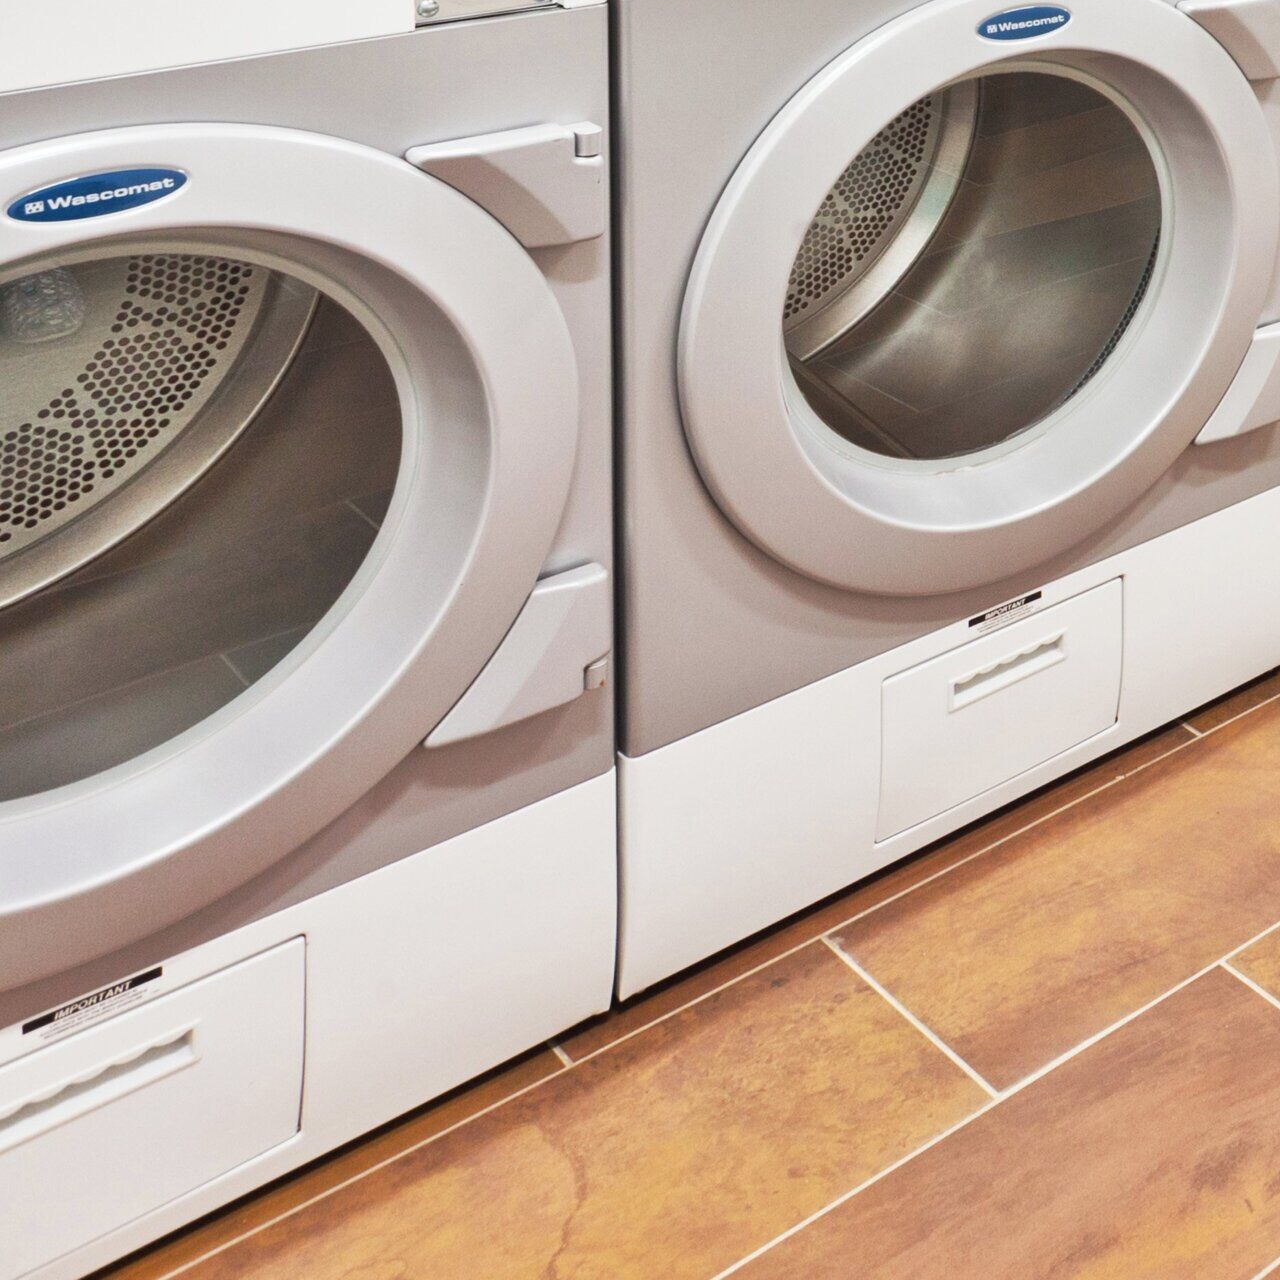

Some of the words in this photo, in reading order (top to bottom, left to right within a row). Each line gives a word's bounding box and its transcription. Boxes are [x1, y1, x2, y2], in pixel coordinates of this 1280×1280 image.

[998, 14, 1064, 32] Wascomat
[47, 177, 174, 210] Wascomat
[54, 980, 132, 1021] IMPORTANT
